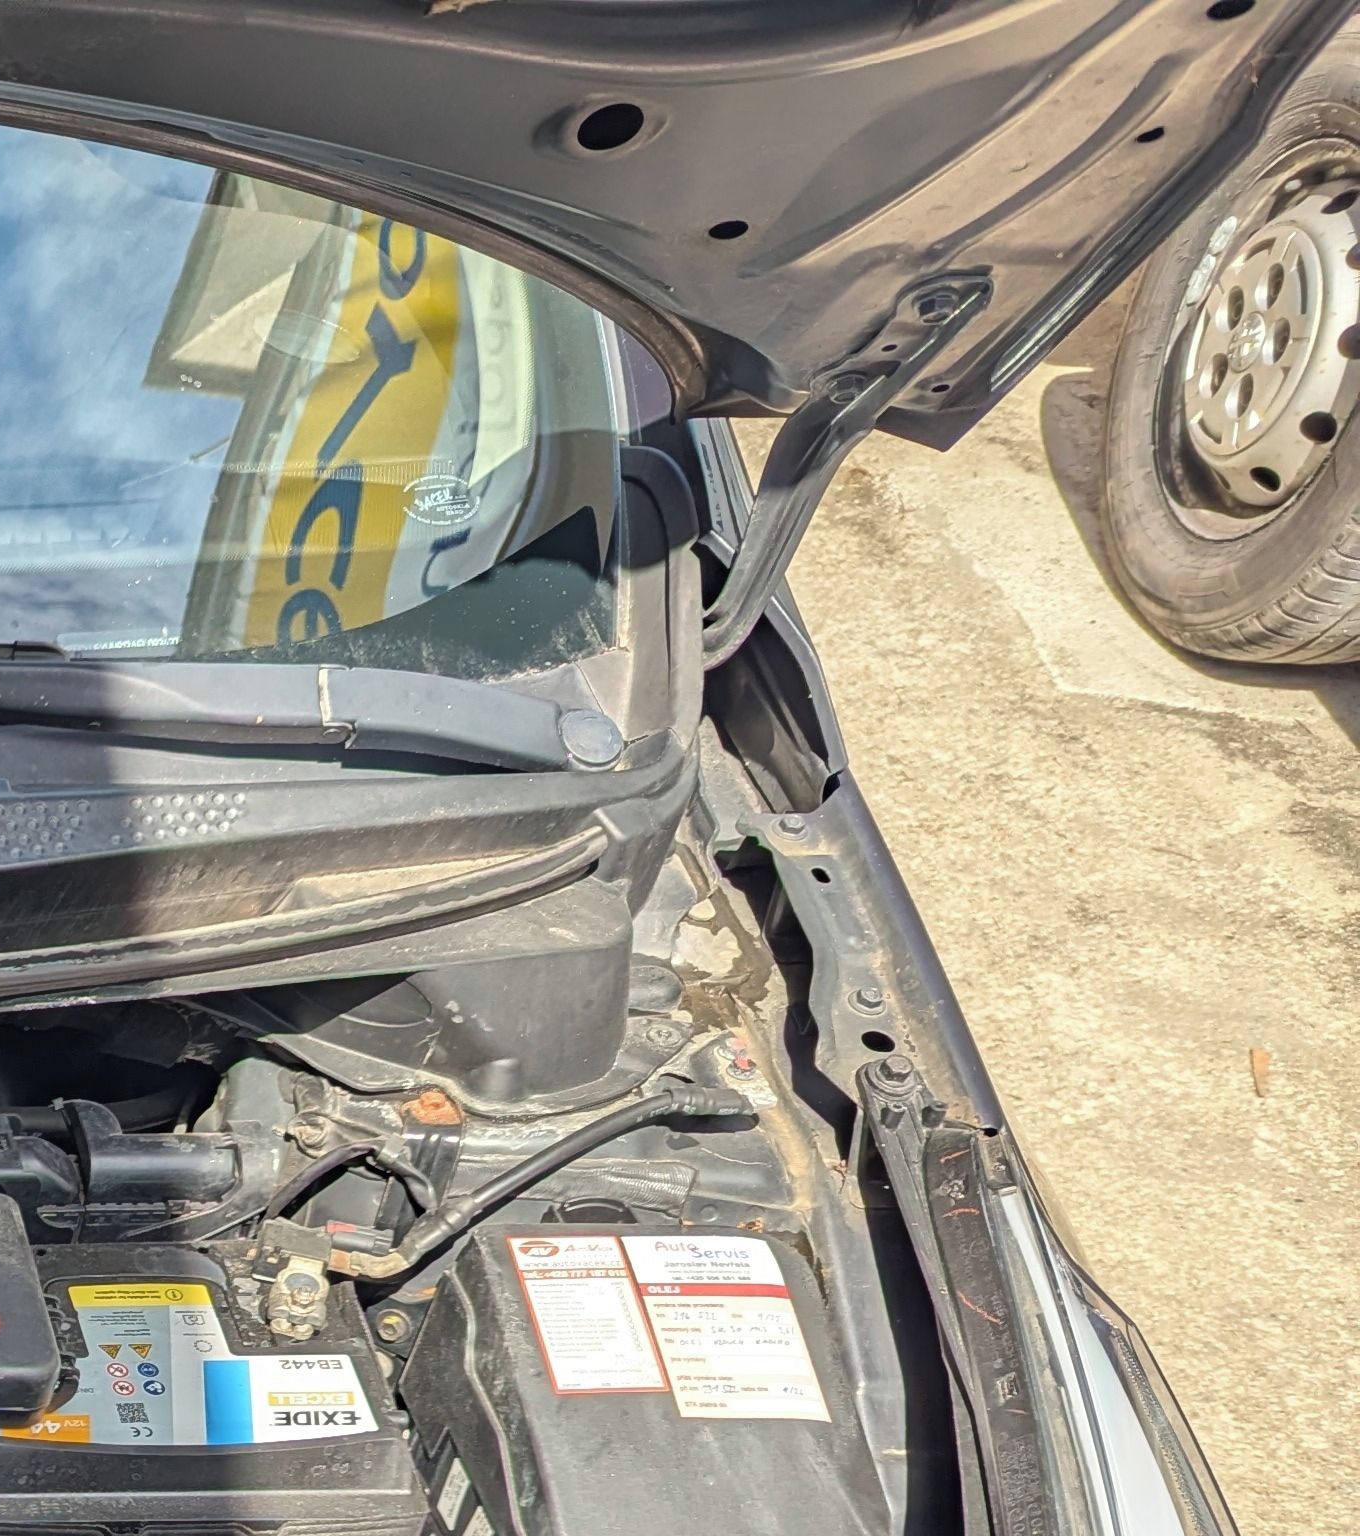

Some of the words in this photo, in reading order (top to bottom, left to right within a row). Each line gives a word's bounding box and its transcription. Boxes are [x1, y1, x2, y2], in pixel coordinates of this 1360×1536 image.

[655, 1240, 700, 1253] Auto
[691, 1248, 750, 1259] Servis
[647, 1285, 681, 1294] OLEJ
[278, 1359, 343, 1370] EB442
[271, 1393, 348, 1405] EXCELL
[63, 1419, 88, 1427] 12V
[273, 1411, 362, 1426] EXIDE
